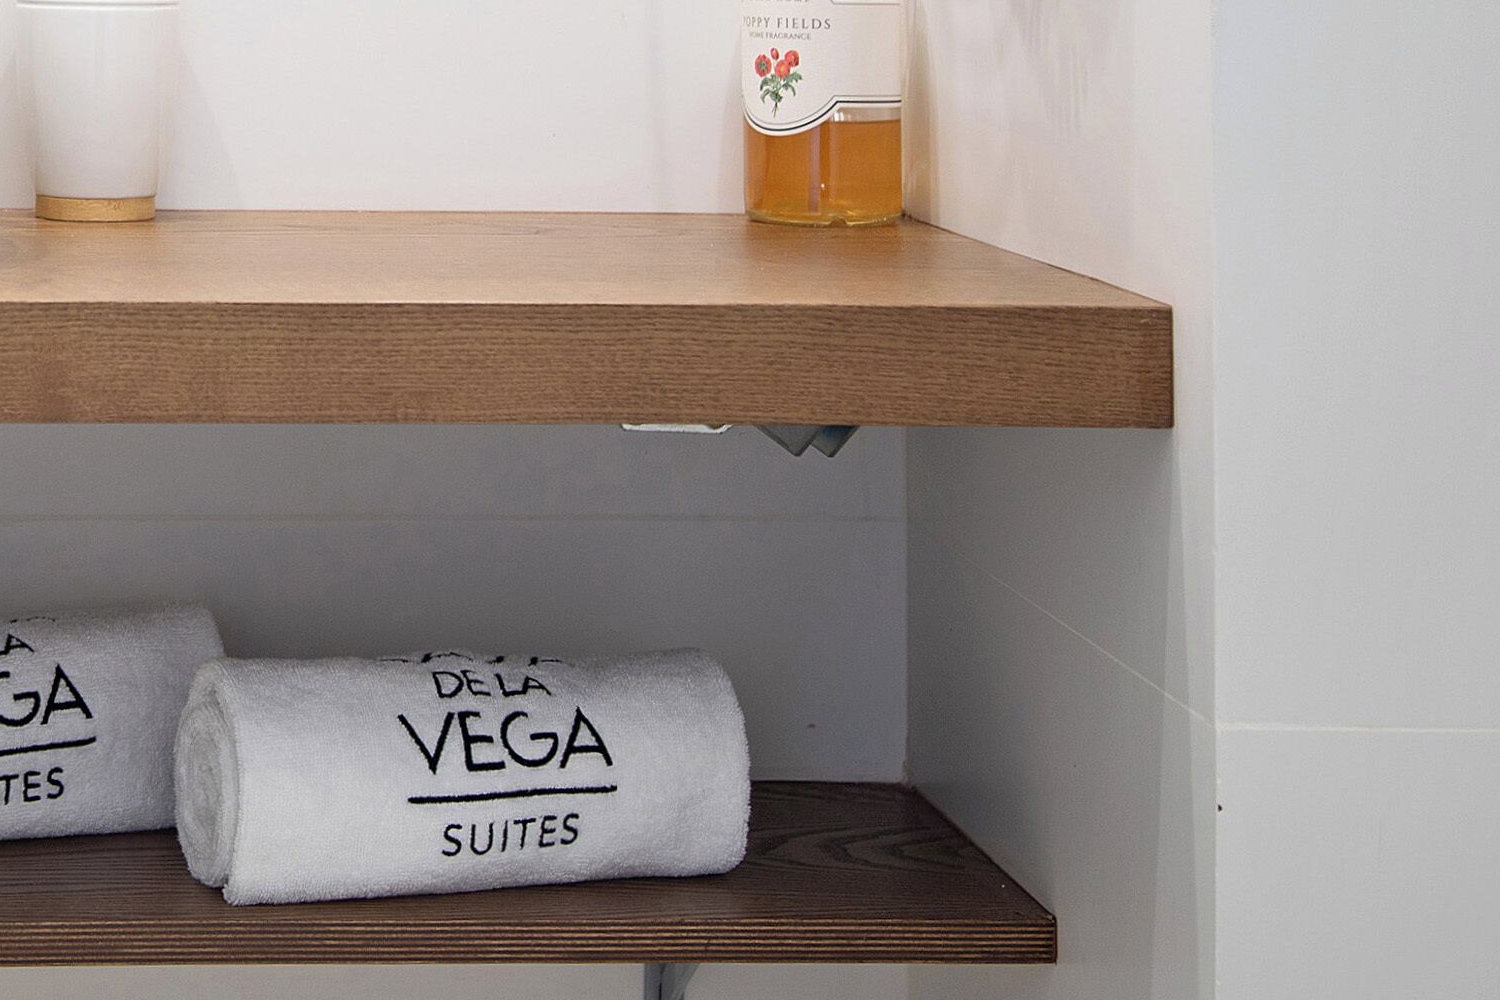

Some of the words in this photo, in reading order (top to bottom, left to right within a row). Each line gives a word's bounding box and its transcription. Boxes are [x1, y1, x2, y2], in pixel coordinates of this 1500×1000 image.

[765, 32, 811, 40] FRAGRANCE
[777, 17, 832, 30] FIELDS
[431, 668, 491, 700] DE
[494, 672, 552, 697] LA
[397, 706, 614, 775] VEGA
[441, 812, 580, 858] SUITES
